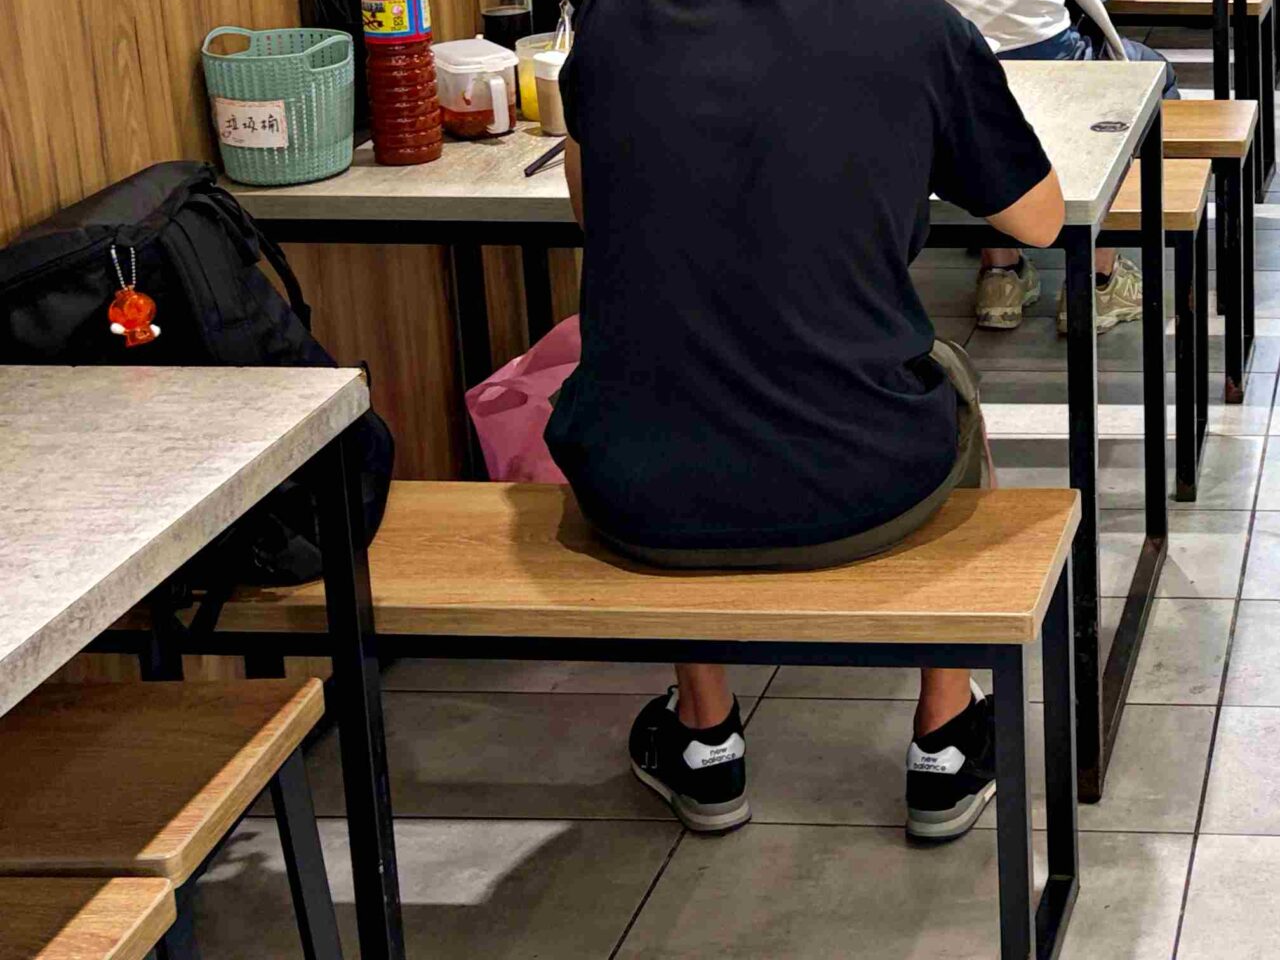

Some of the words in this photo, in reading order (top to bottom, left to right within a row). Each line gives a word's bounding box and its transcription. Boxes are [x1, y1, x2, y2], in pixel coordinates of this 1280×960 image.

[225, 113, 280, 134] 垃圾桶
[709, 746, 728, 757] new
[701, 752, 737, 766] balance
[920, 756, 938, 764] new
[912, 762, 947, 772] balance
